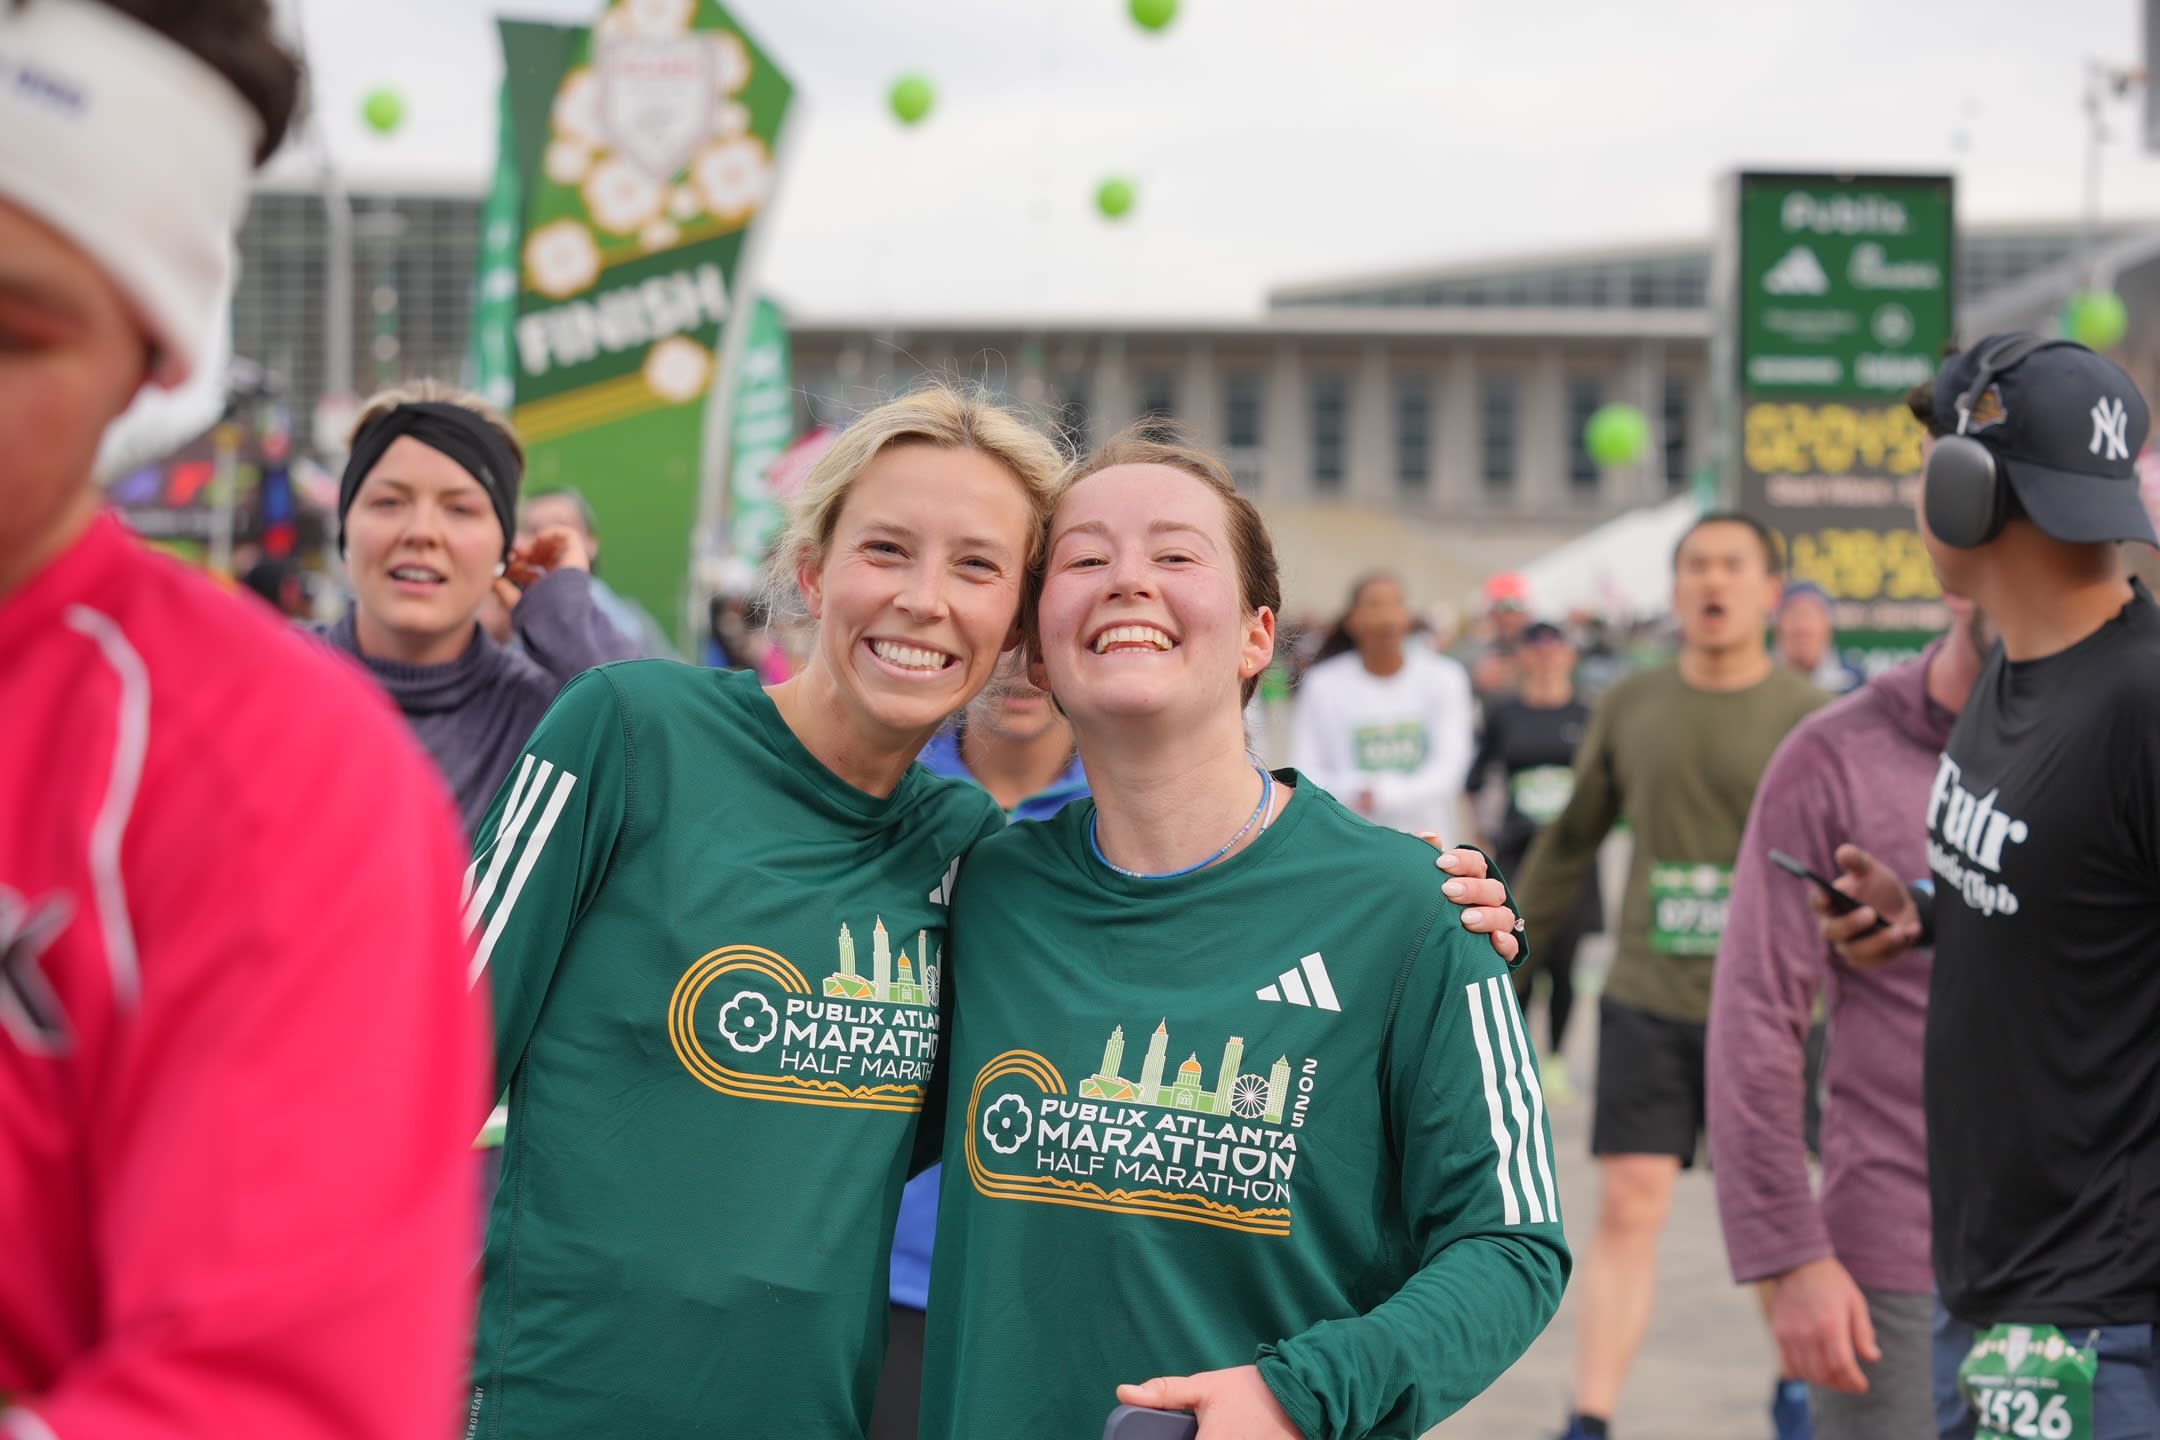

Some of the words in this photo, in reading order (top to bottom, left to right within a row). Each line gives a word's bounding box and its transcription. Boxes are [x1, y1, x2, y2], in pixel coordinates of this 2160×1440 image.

[517, 264, 729, 376] FINISH
[782, 1018, 940, 1059] MARATHO
[785, 998, 885, 1026] PUBLIX
[891, 1009, 941, 1031] ATLAN
[779, 1049, 853, 1075] HALF
[860, 1057, 935, 1082] MARATH
[1290, 1057, 1318, 1128] 2025
[1037, 1119, 1297, 1180] MARATHON
[1039, 1098, 1149, 1128] PUBLIX
[1154, 1112, 1298, 1152] ATLANTA
[1036, 1149, 1105, 1178] HALF
[1114, 1158, 1292, 1204] MARATHON
